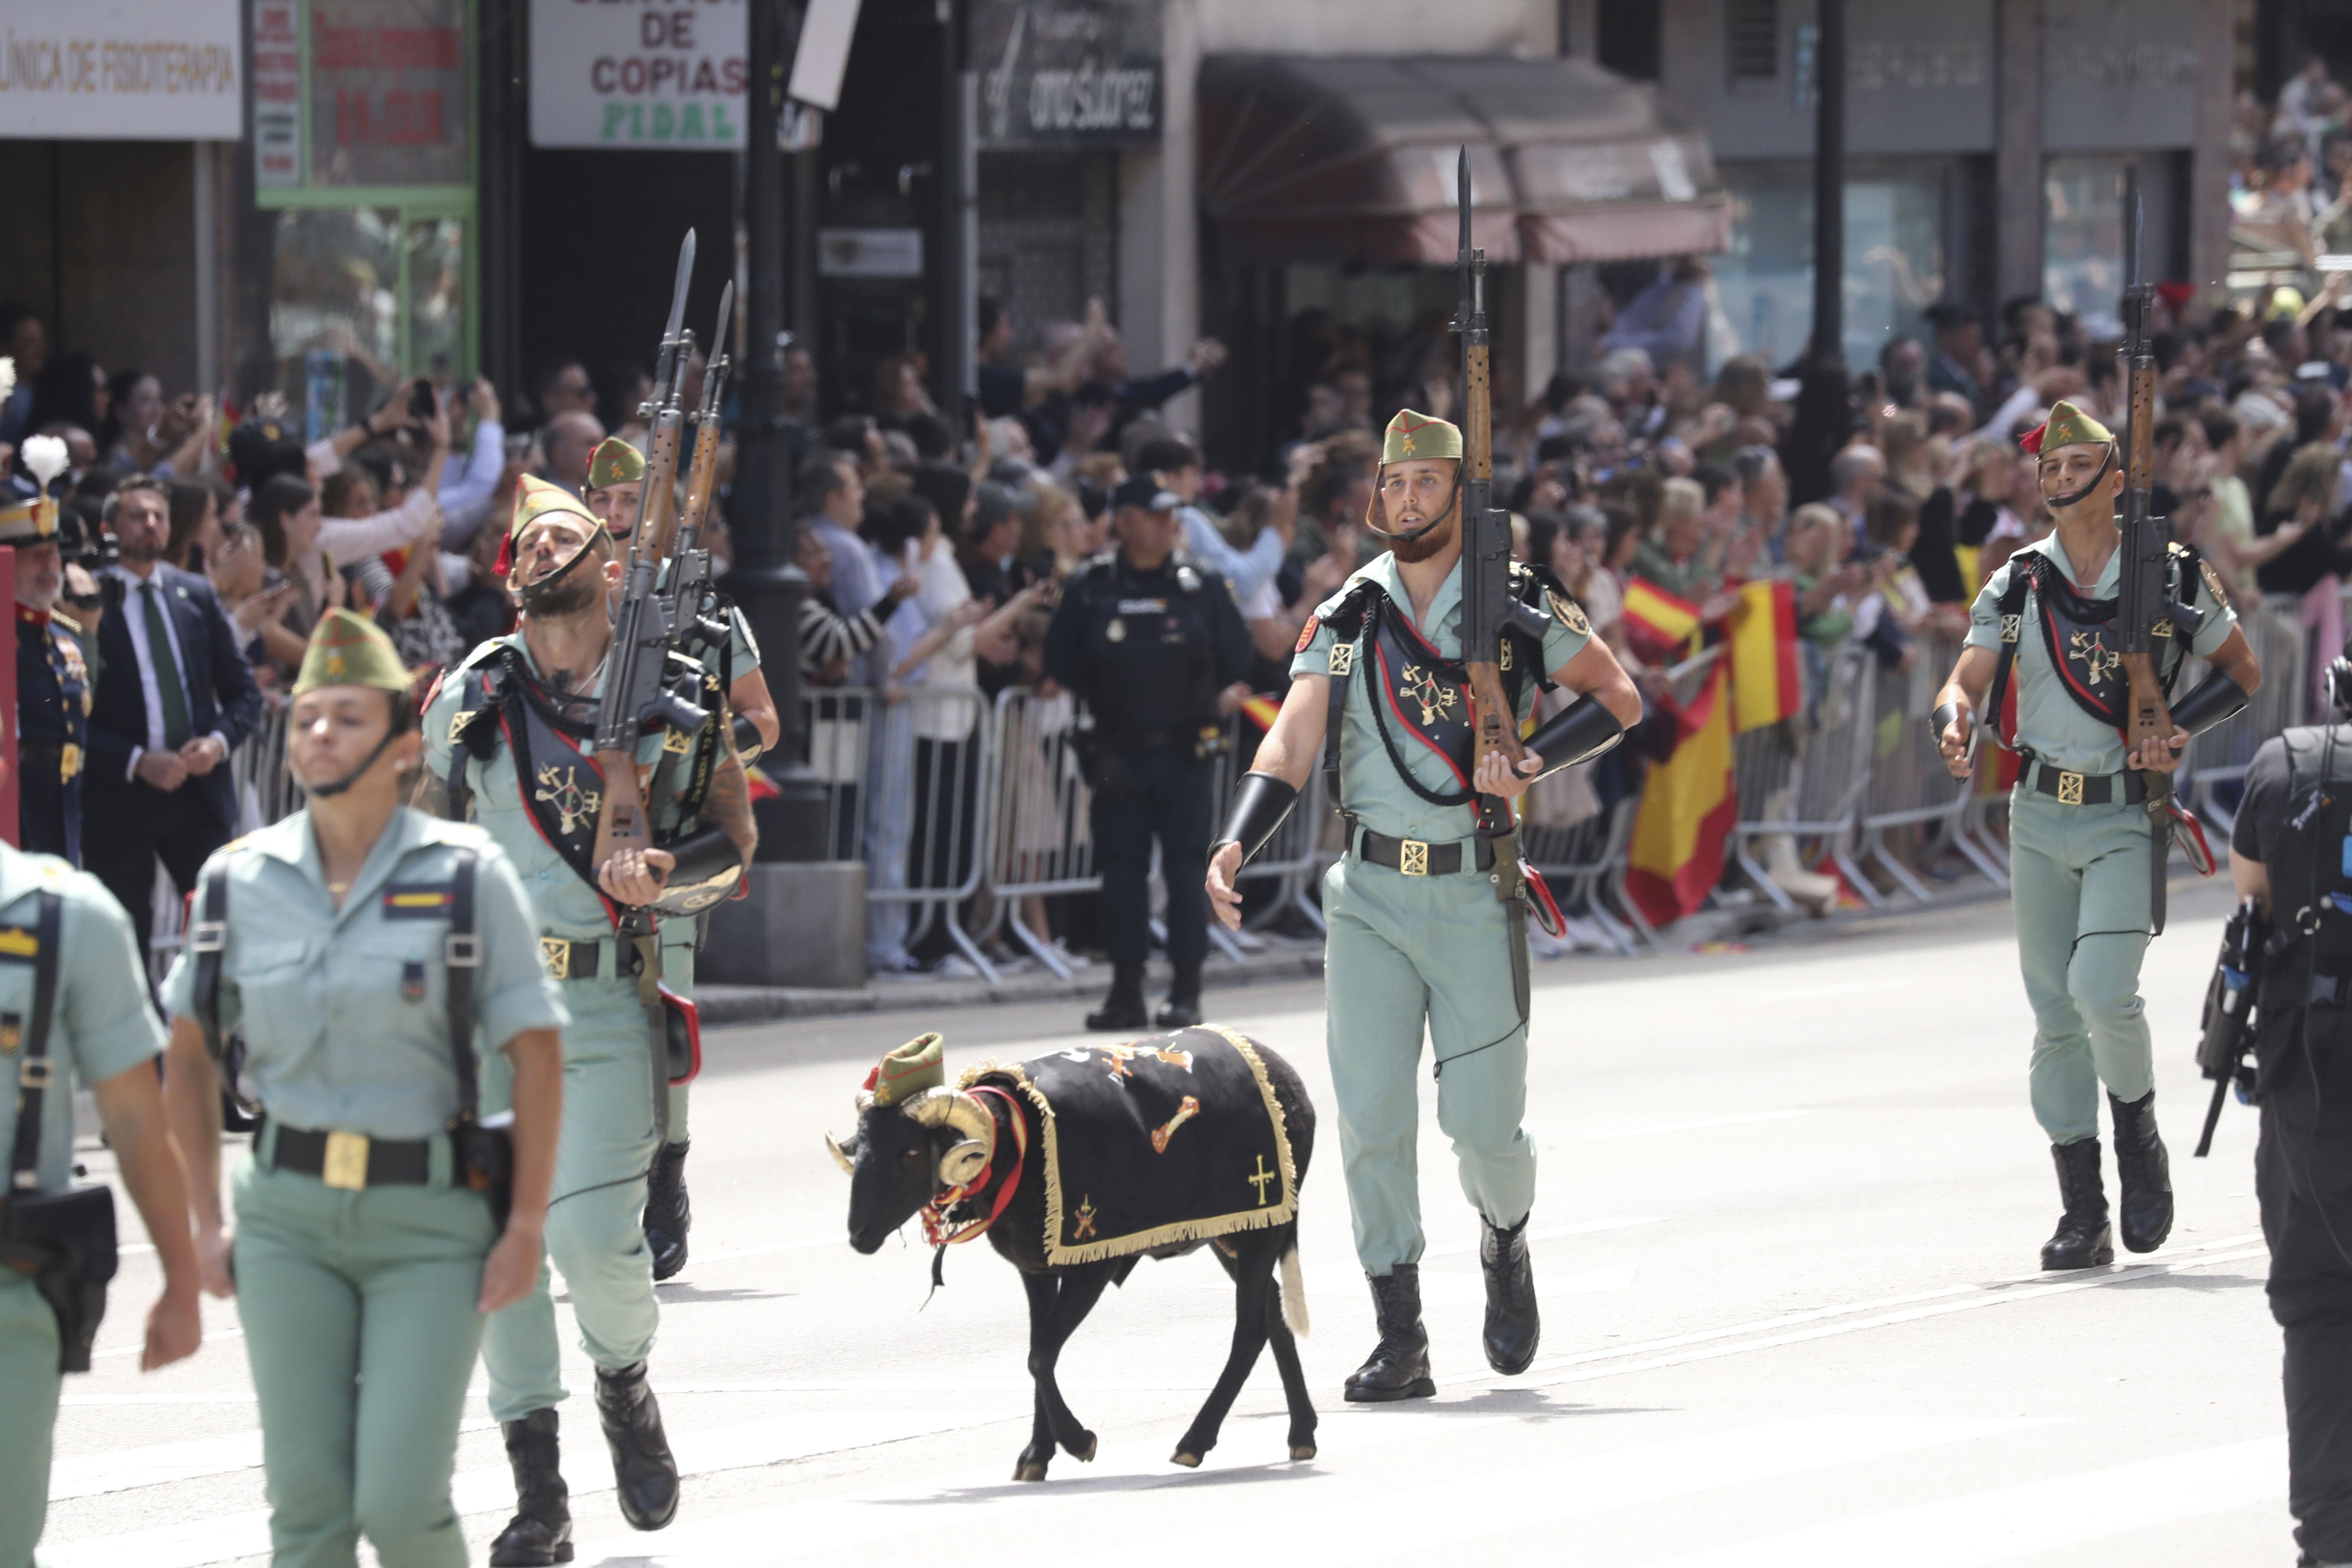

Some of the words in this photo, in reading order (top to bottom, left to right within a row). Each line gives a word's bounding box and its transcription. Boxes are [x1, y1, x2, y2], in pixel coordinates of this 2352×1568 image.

[640, 11, 695, 49] DE
[67, 40, 95, 92] DE
[101, 40, 233, 93] FISIOTERAPIA
[591, 56, 748, 95] COPIAS
[600, 100, 737, 141] PIDAL
